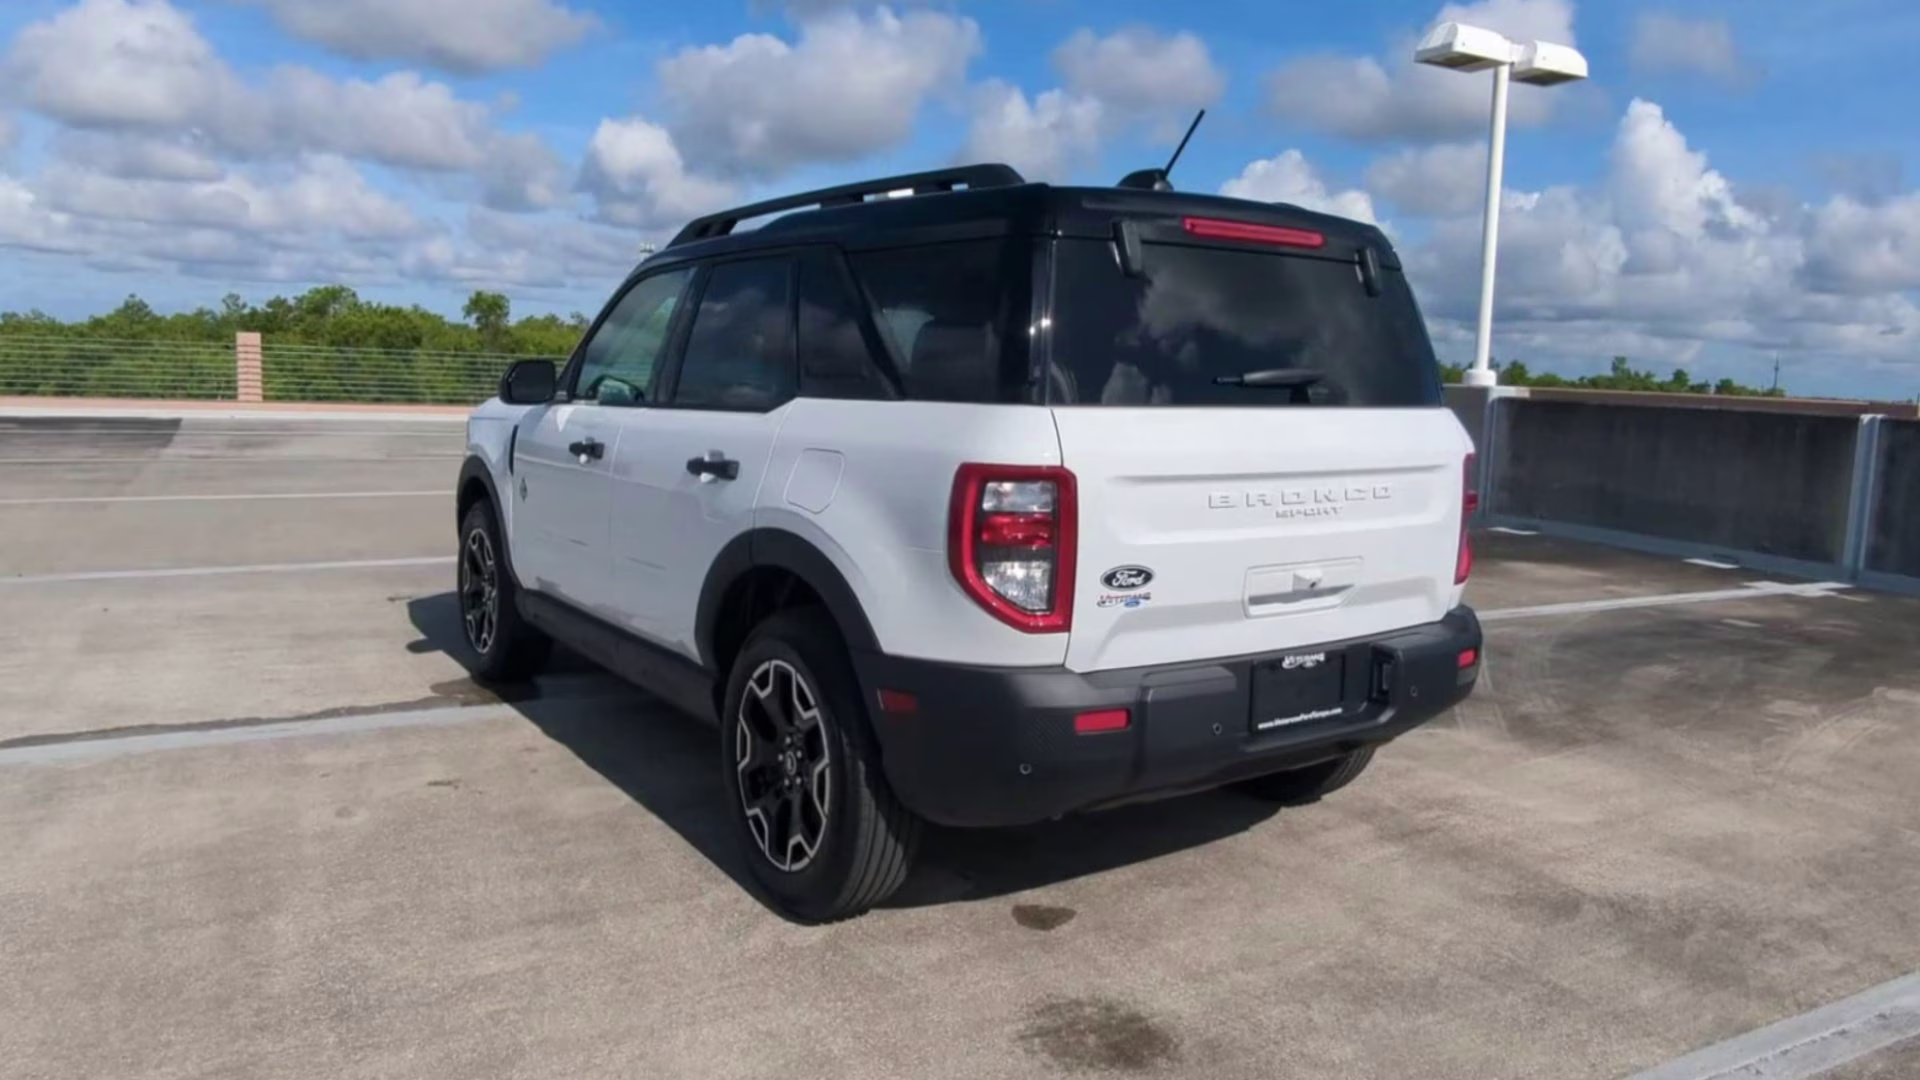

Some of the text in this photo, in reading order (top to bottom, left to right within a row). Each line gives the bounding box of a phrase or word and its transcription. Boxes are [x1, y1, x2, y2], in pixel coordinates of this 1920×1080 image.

[1208, 484, 1392, 509] BRONCO
[1275, 505, 1343, 519] SPORT
[1112, 570, 1146, 586] Ford
